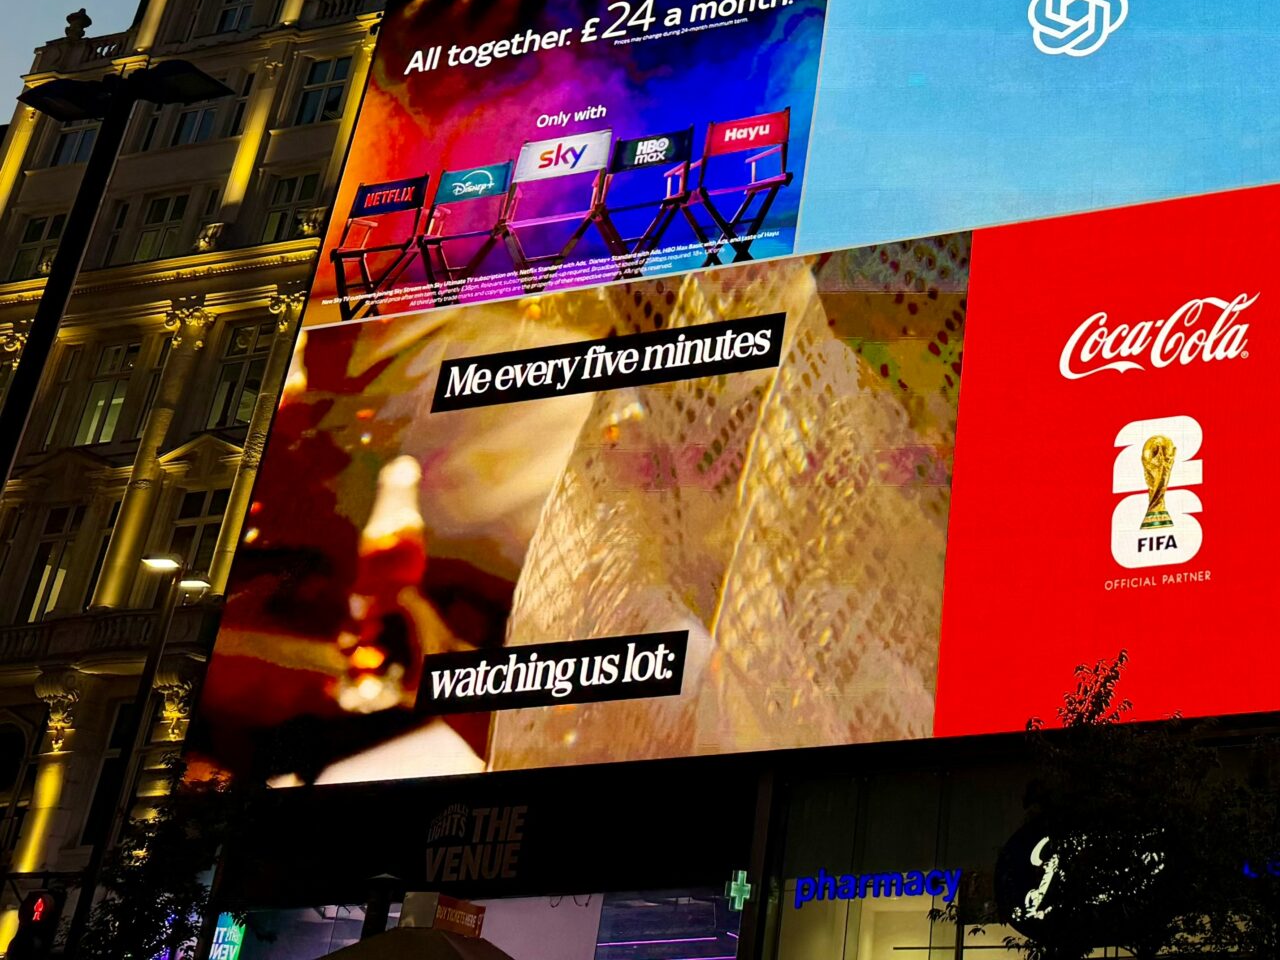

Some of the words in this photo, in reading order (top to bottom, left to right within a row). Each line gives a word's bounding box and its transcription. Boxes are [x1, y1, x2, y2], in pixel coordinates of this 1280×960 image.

[404, 45, 441, 74] All
[448, 28, 573, 68] together.
[664, 7, 682, 27] a
[663, 29, 681, 37] during
[536, 111, 571, 128] Only
[575, 104, 607, 122] with
[725, 124, 770, 142] Hayu
[538, 143, 589, 169] sky
[634, 151, 666, 165] max
[636, 137, 670, 155] HBO
[364, 186, 416, 209] NETFLIX
[452, 178, 495, 196] Disney+
[1059, 292, 1260, 380] Coca-Cola
[445, 364, 491, 398] Me
[495, 356, 582, 391] every
[582, 346, 640, 380] five
[642, 329, 772, 372] minutes
[1138, 535, 1178, 552] FIFA
[1104, 576, 1157, 591] OFFICIAL
[1162, 571, 1211, 585] PARTNER
[432, 652, 577, 698] watching
[580, 654, 620, 687] us
[622, 643, 675, 683] lot:
[471, 804, 529, 844] THE
[425, 842, 521, 883] VENUE
[794, 868, 963, 909] pharmacy
